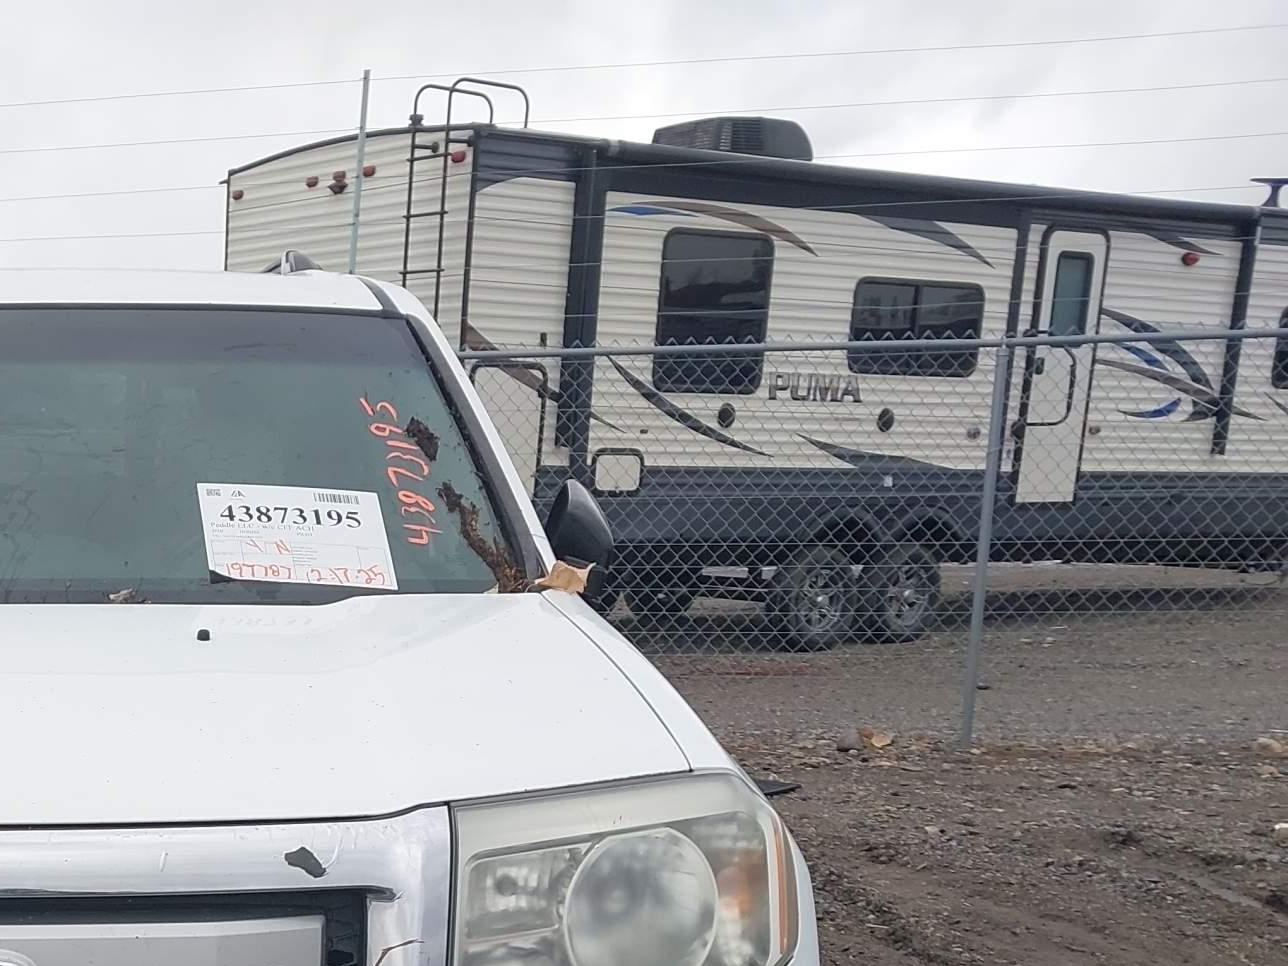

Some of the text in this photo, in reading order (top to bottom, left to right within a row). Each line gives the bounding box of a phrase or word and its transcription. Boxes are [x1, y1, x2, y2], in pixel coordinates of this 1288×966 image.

[768, 371, 863, 403] PUMA
[358, 396, 444, 545] 43873195
[219, 503, 363, 529] 43873195
